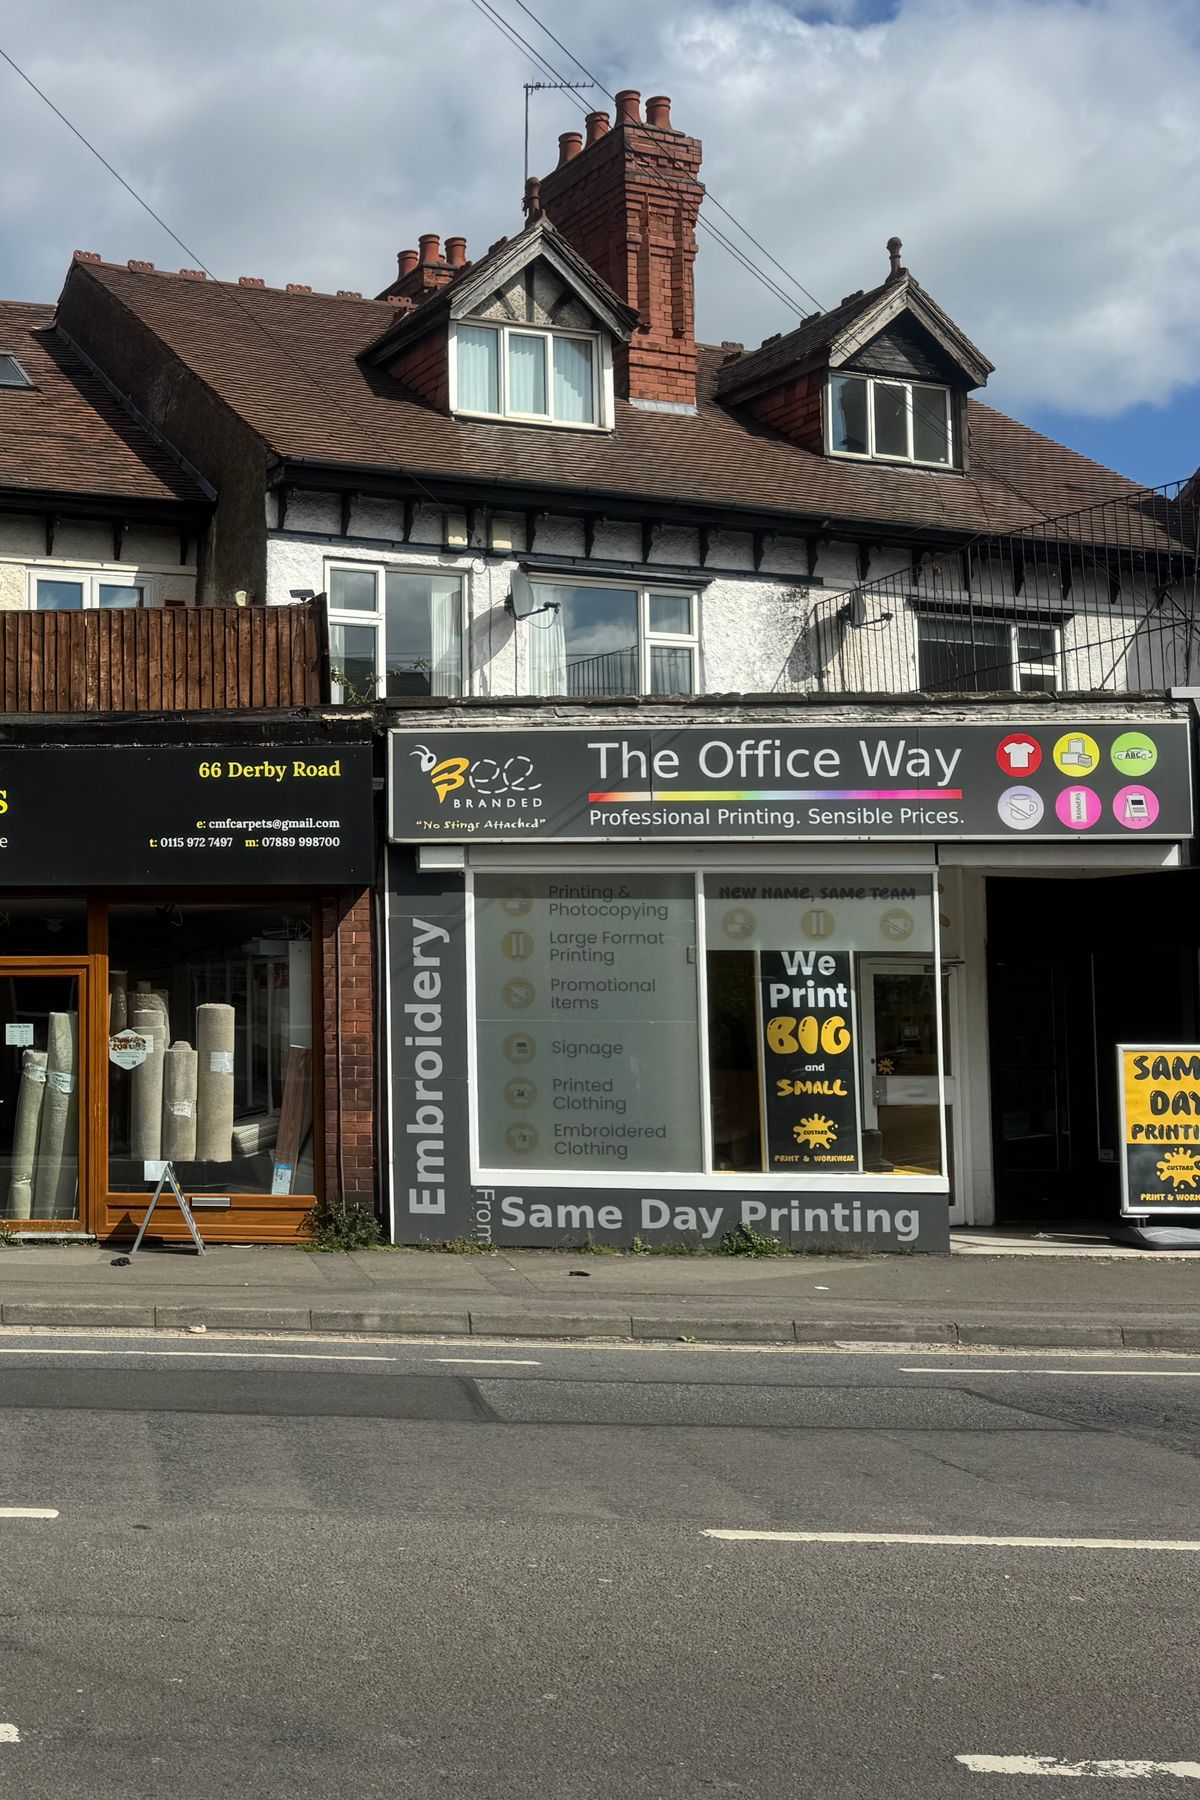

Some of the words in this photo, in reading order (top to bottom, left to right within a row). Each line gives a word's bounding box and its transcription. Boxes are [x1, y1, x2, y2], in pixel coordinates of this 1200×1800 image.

[199, 762, 221, 777] 66
[228, 761, 287, 782] Derby
[293, 760, 341, 776] Road
[588, 741, 679, 778] The
[699, 740, 840, 778] Office
[860, 741, 961, 786] Way
[454, 798, 542, 808] BRANDED
[209, 818, 340, 831] cmfcarpets@gmail.com
[443, 820, 481, 832] Stings
[591, 809, 709, 825] Professional
[719, 809, 800, 828] Printing.
[809, 808, 892, 824] Sensible
[901, 808, 964, 824] Prices.
[150, 838, 158, 848] t:
[161, 838, 184, 847] 0115
[187, 838, 205, 847] 972
[209, 838, 233, 847] 7497
[262, 837, 295, 847] 07889
[299, 837, 341, 847] 998700
[549, 885, 614, 901] Printing
[618, 886, 631, 899] &
[550, 902, 668, 920] Photocopying
[550, 932, 597, 947] Large
[603, 931, 664, 944] Format
[551, 948, 614, 966] Printing
[781, 950, 838, 975] We
[551, 978, 655, 992] Promotional
[770, 980, 847, 1007] Print
[552, 997, 598, 1009] Items
[767, 1015, 852, 1054] BIG
[552, 1040, 623, 1058] Signage
[405, 918, 449, 1214] Embroidery
[805, 1063, 824, 1071] and
[553, 1078, 613, 1092] Printed
[776, 1078, 848, 1097] SMALL
[553, 1096, 626, 1114] Clothing
[554, 1124, 665, 1137] Embroidered
[555, 1141, 627, 1160] Clothing
[1141, 1193, 1165, 1201] PRINT
[1167, 1193, 1173, 1201] &
[476, 1189, 495, 1245] From
[500, 1196, 622, 1229] Same
[641, 1198, 724, 1233] Day
[742, 1200, 921, 1241] Printing
